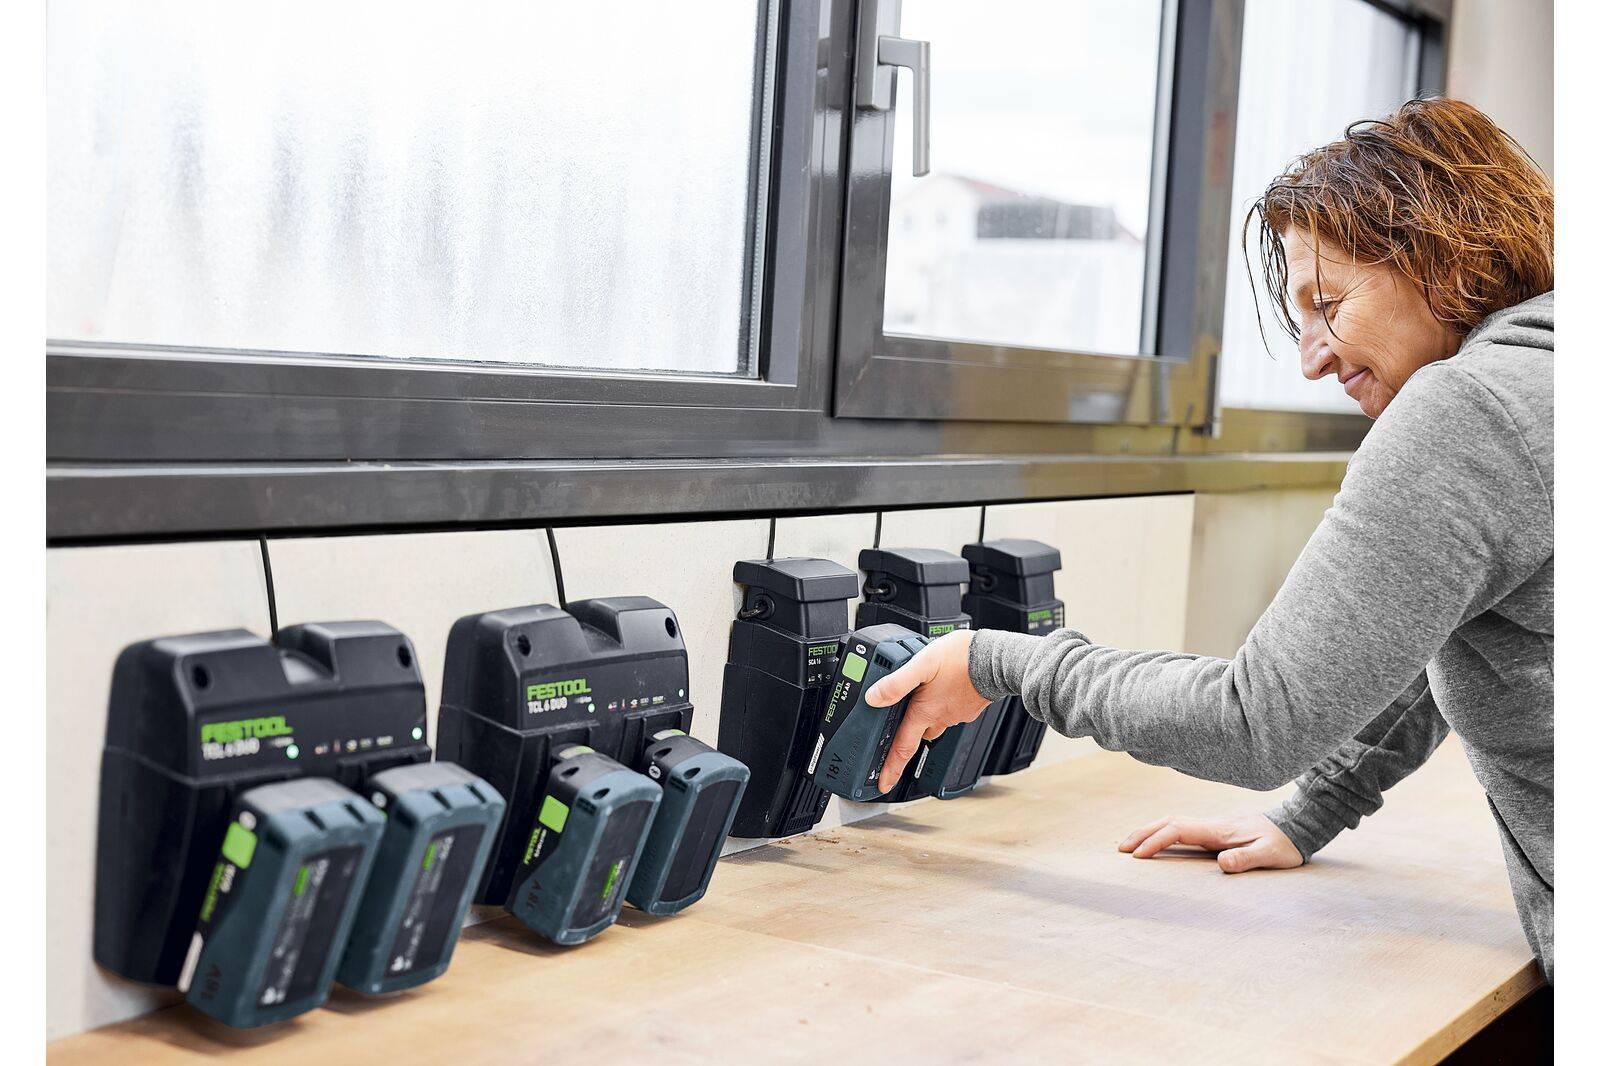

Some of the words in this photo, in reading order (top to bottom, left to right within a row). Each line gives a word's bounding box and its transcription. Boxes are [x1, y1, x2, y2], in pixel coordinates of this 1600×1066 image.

[527, 678, 592, 701] FESTOOL
[844, 682, 851, 691] Ah
[527, 699, 544, 714] TCL
[549, 696, 568, 711] DUO
[825, 680, 845, 723] FESTOOL
[201, 715, 294, 744] FESTOOL
